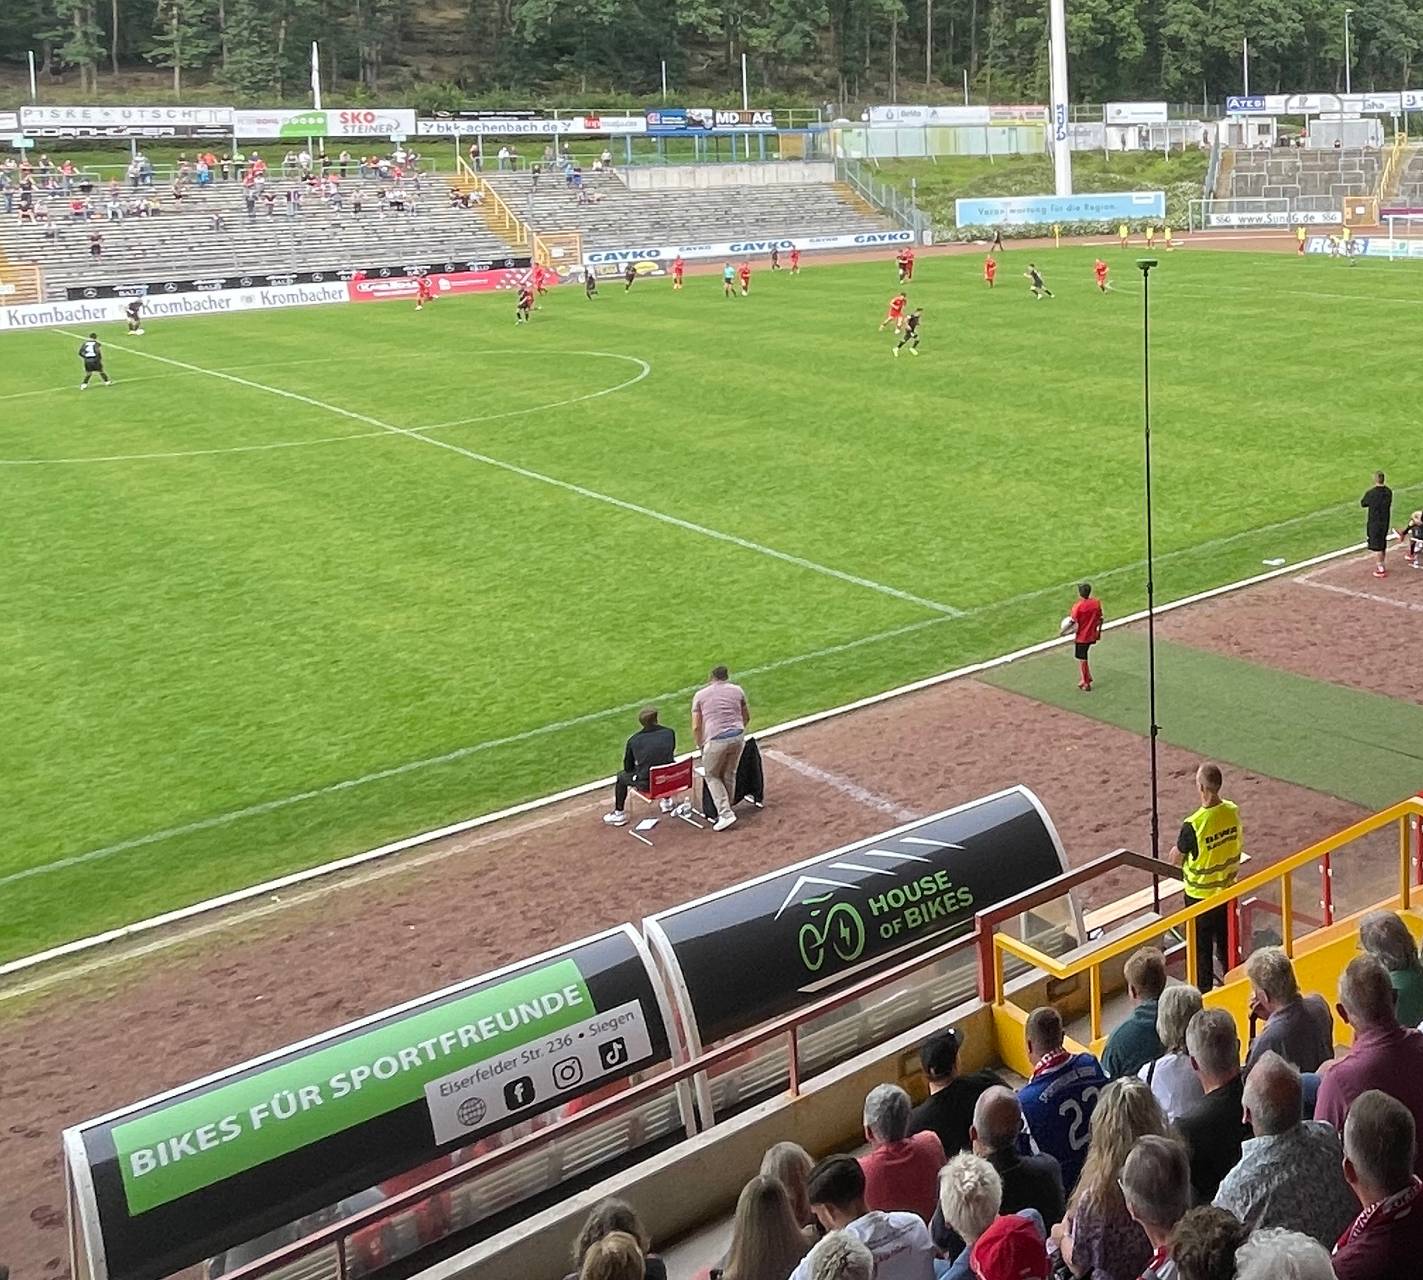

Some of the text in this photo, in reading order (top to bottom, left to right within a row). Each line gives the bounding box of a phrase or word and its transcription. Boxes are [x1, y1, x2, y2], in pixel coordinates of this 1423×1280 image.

[23, 109, 192, 119] PISKE UTSCH
[339, 111, 376, 124] SKO
[715, 111, 774, 123] MD AG
[342, 124, 394, 134] STEINER
[436, 122, 558, 133] bkk-achenbach.de
[854, 232, 911, 243] GAYKO
[729, 240, 793, 252] GAYKO
[588, 249, 661, 263] GAYKO
[260, 287, 344, 305] Krombacher
[142, 294, 231, 316] Krombacher
[7, 306, 107, 326] Krombacher
[868, 869, 952, 917] HOUSE
[879, 886, 974, 939] OF BIKES
[439, 1010, 635, 1098] Eiserfelder Str. 236 Siegen
[131, 982, 583, 1178] BIKES FÜR SPORTFREUNDE
